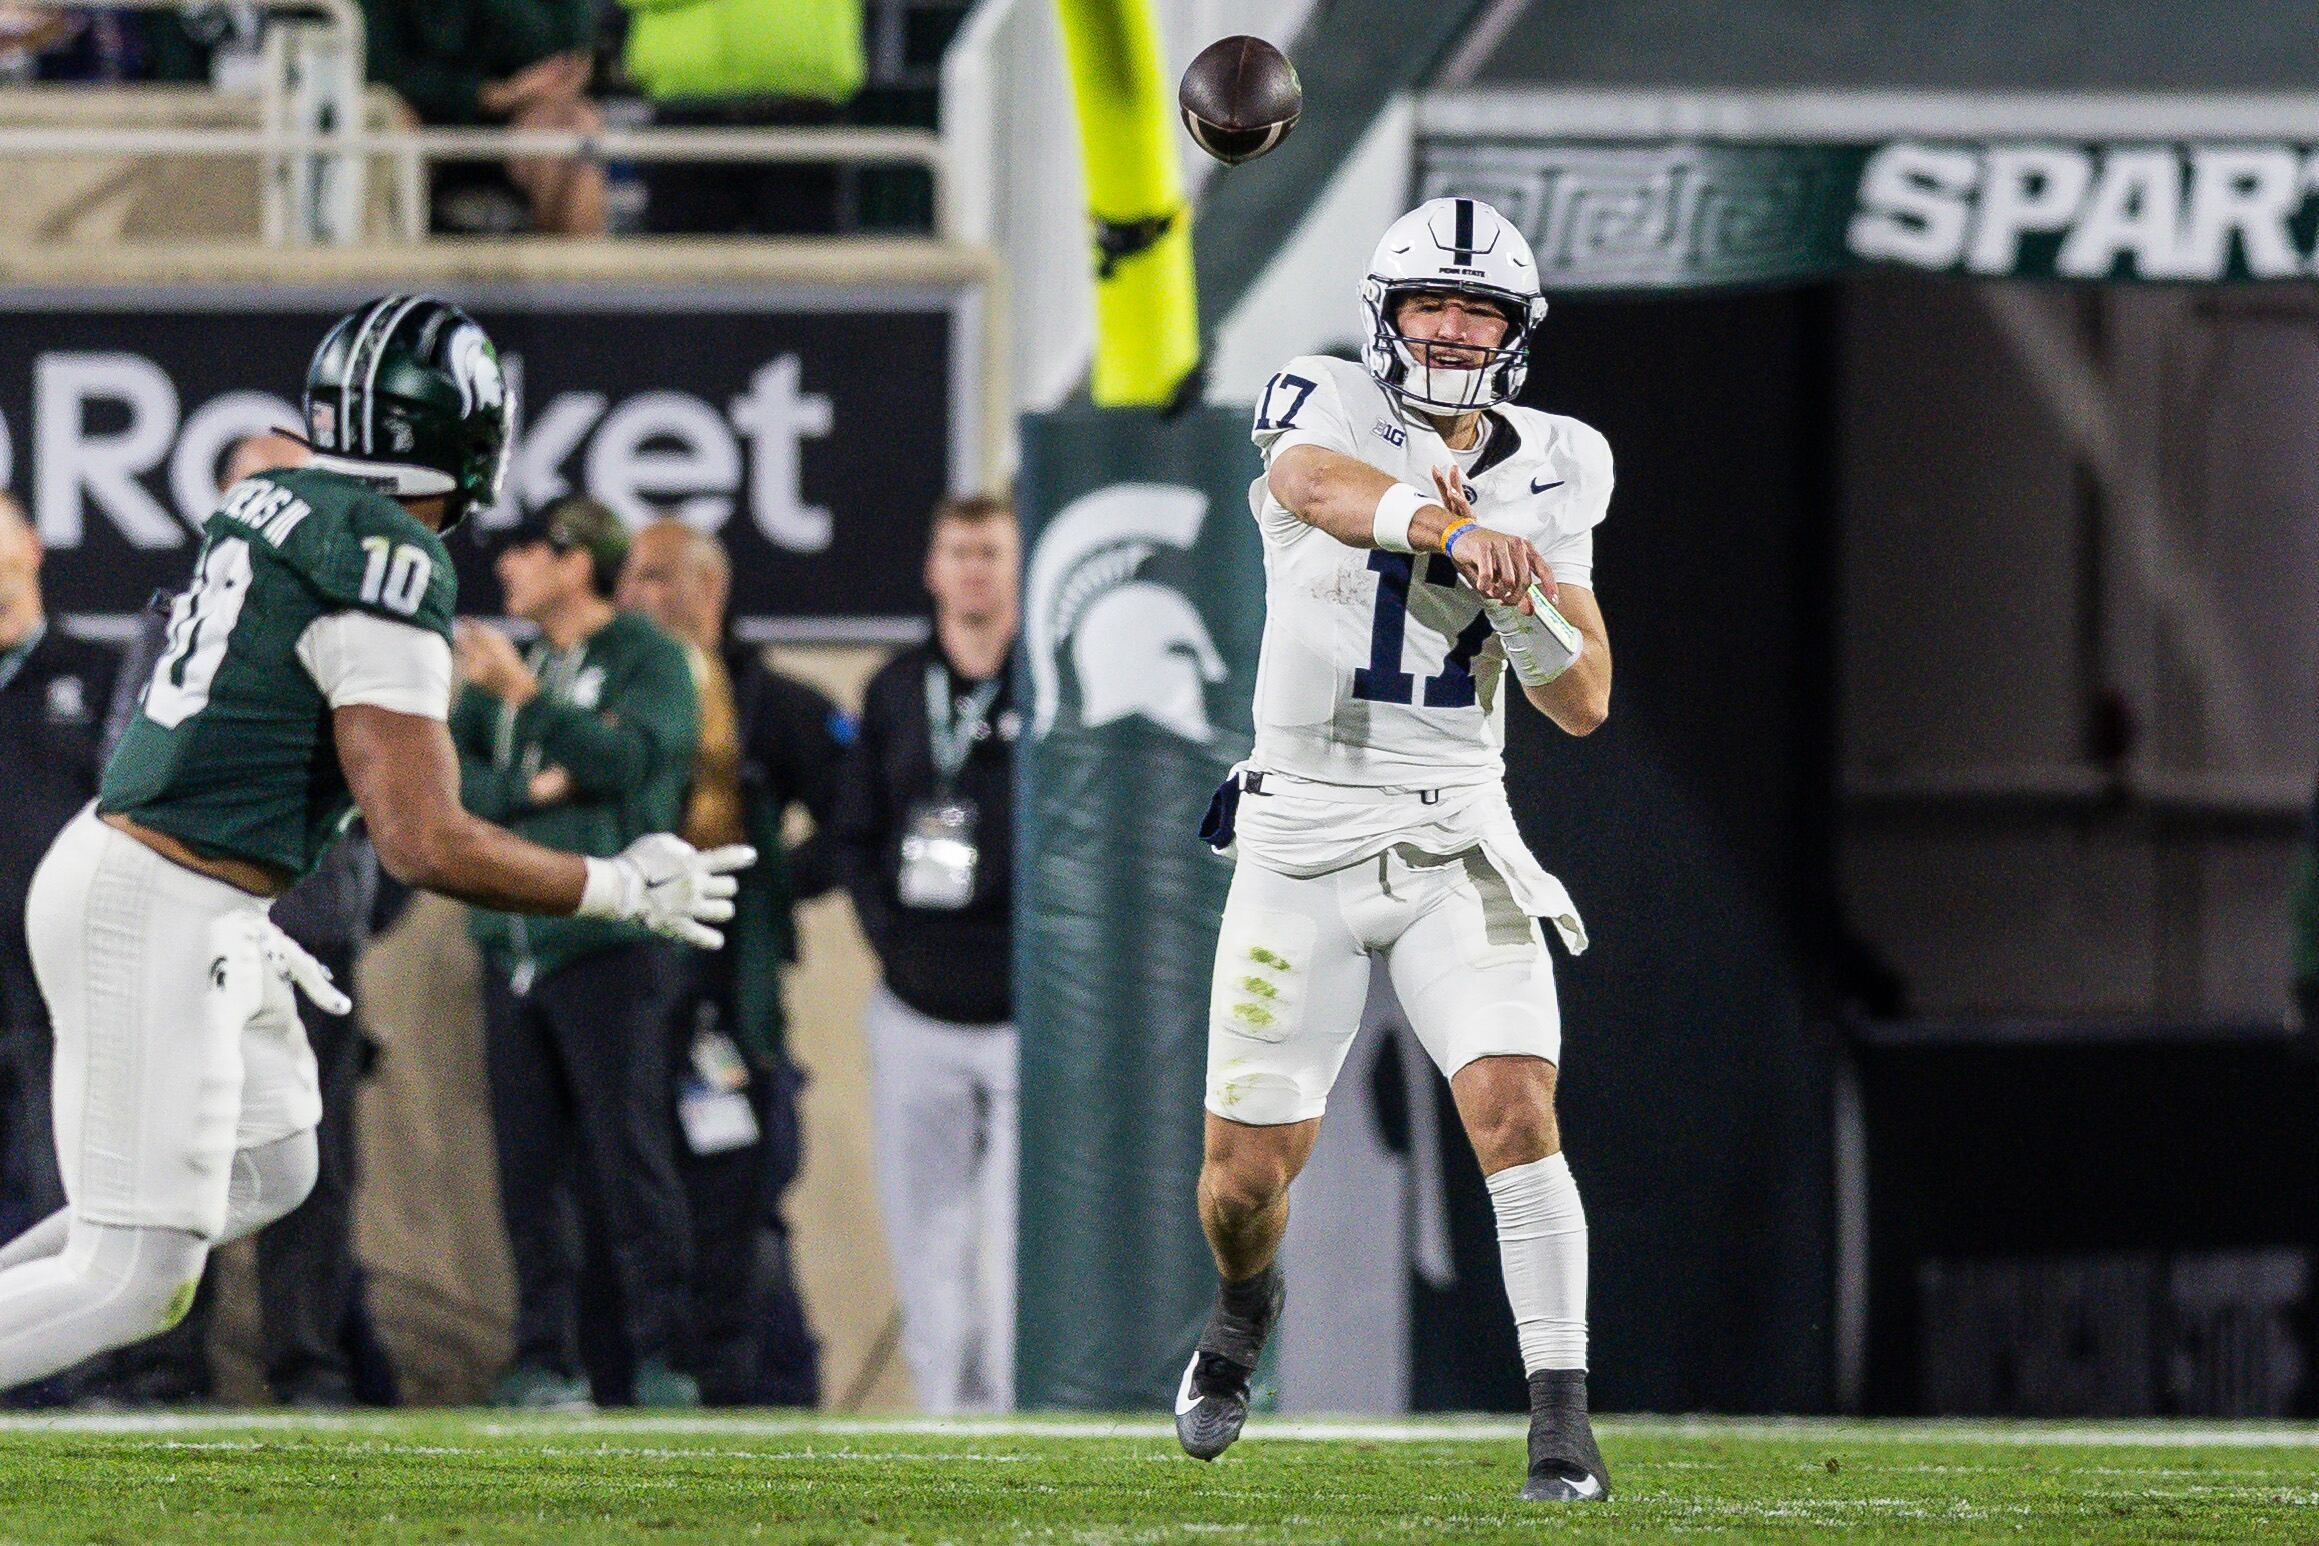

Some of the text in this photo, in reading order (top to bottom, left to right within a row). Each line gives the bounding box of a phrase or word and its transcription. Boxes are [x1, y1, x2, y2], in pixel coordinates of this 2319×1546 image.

[1846, 144, 2319, 281] SPAR
[1438, 267, 1486, 278] PENN STATE
[1256, 373, 1318, 430] 17
[34, 350, 834, 552] Roket
[361, 536, 432, 615] 10
